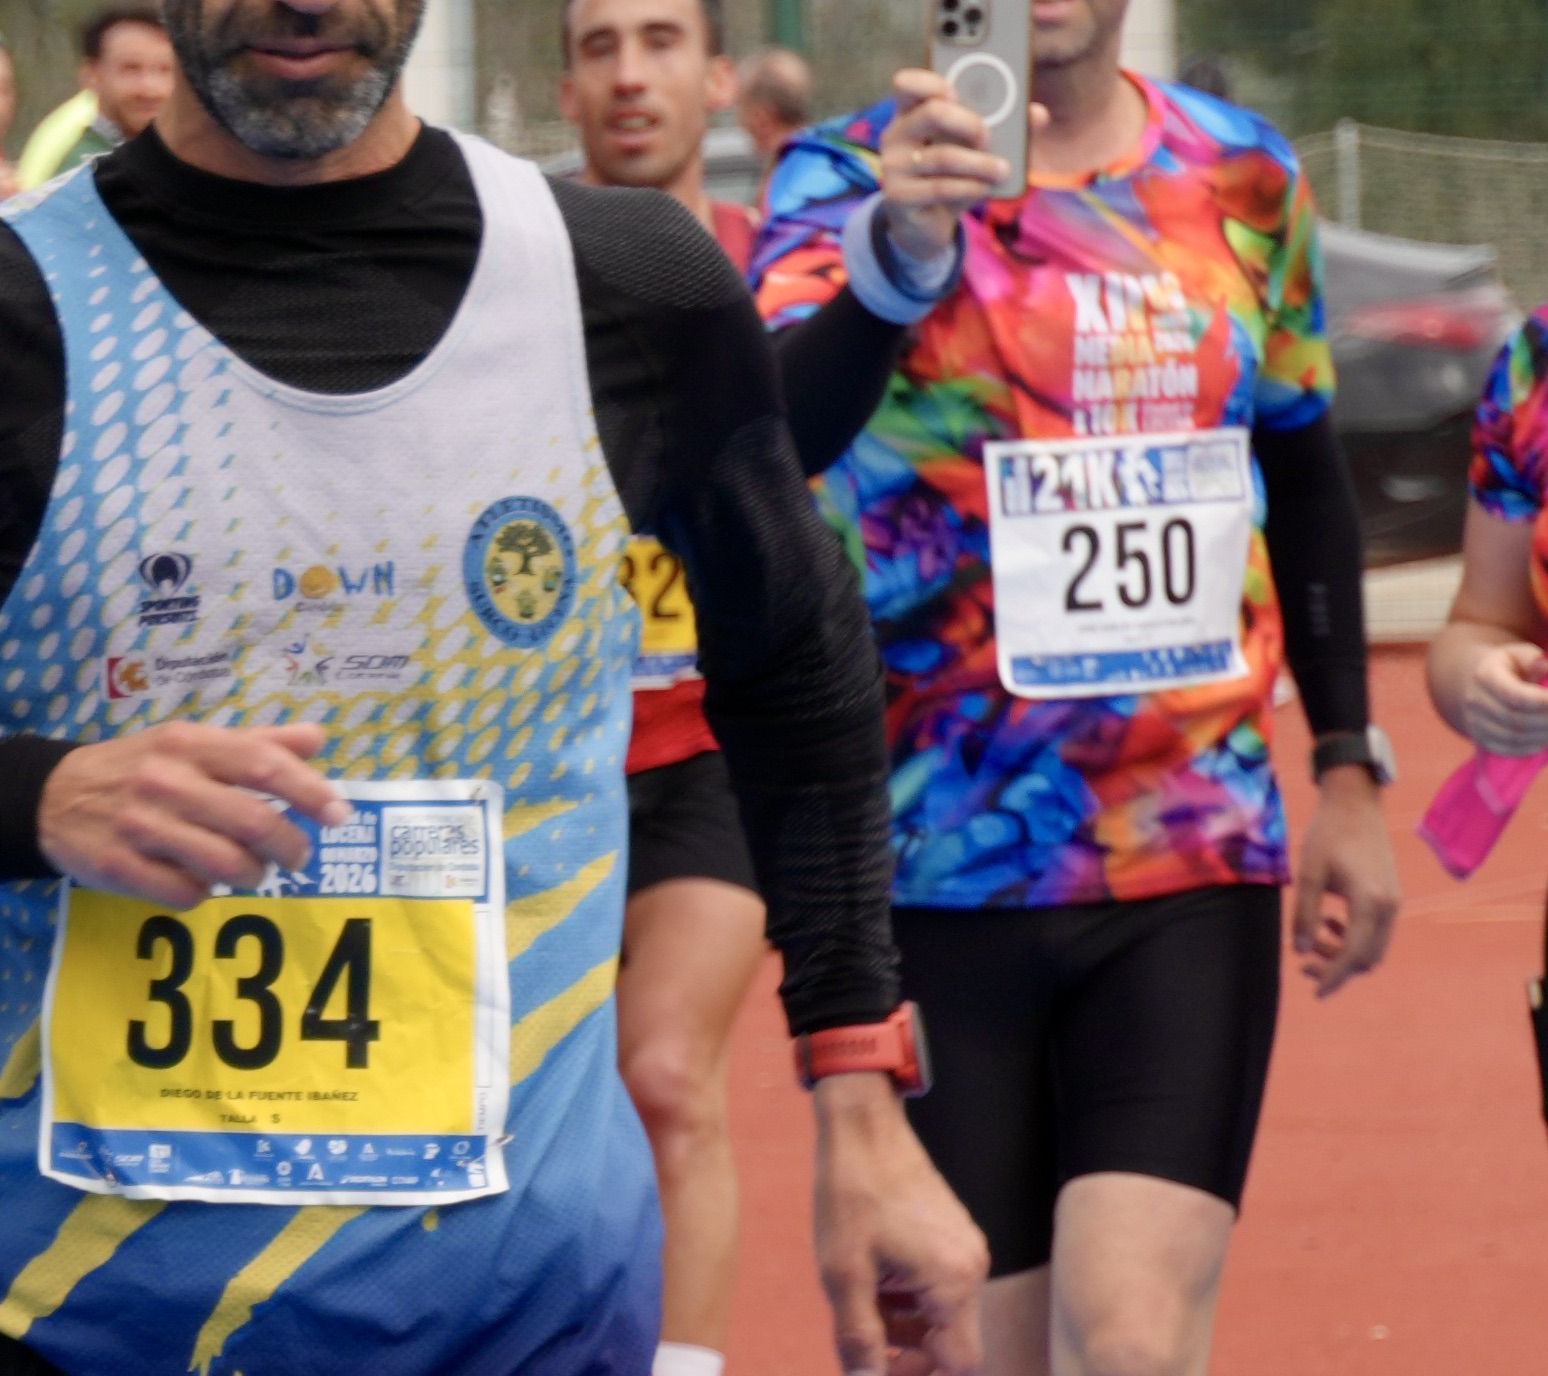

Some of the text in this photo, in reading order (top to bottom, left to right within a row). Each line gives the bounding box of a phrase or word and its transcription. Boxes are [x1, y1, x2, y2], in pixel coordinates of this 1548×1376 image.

[1061, 518, 1197, 613] 250
[391, 838, 479, 859] populares
[319, 863, 378, 894] 2026
[127, 913, 382, 1071] 334
[160, 1088, 202, 1099] DIEGO
[205, 1089, 222, 1100] DE
[228, 1090, 243, 1100] LA
[248, 1090, 303, 1101] FUENTE
